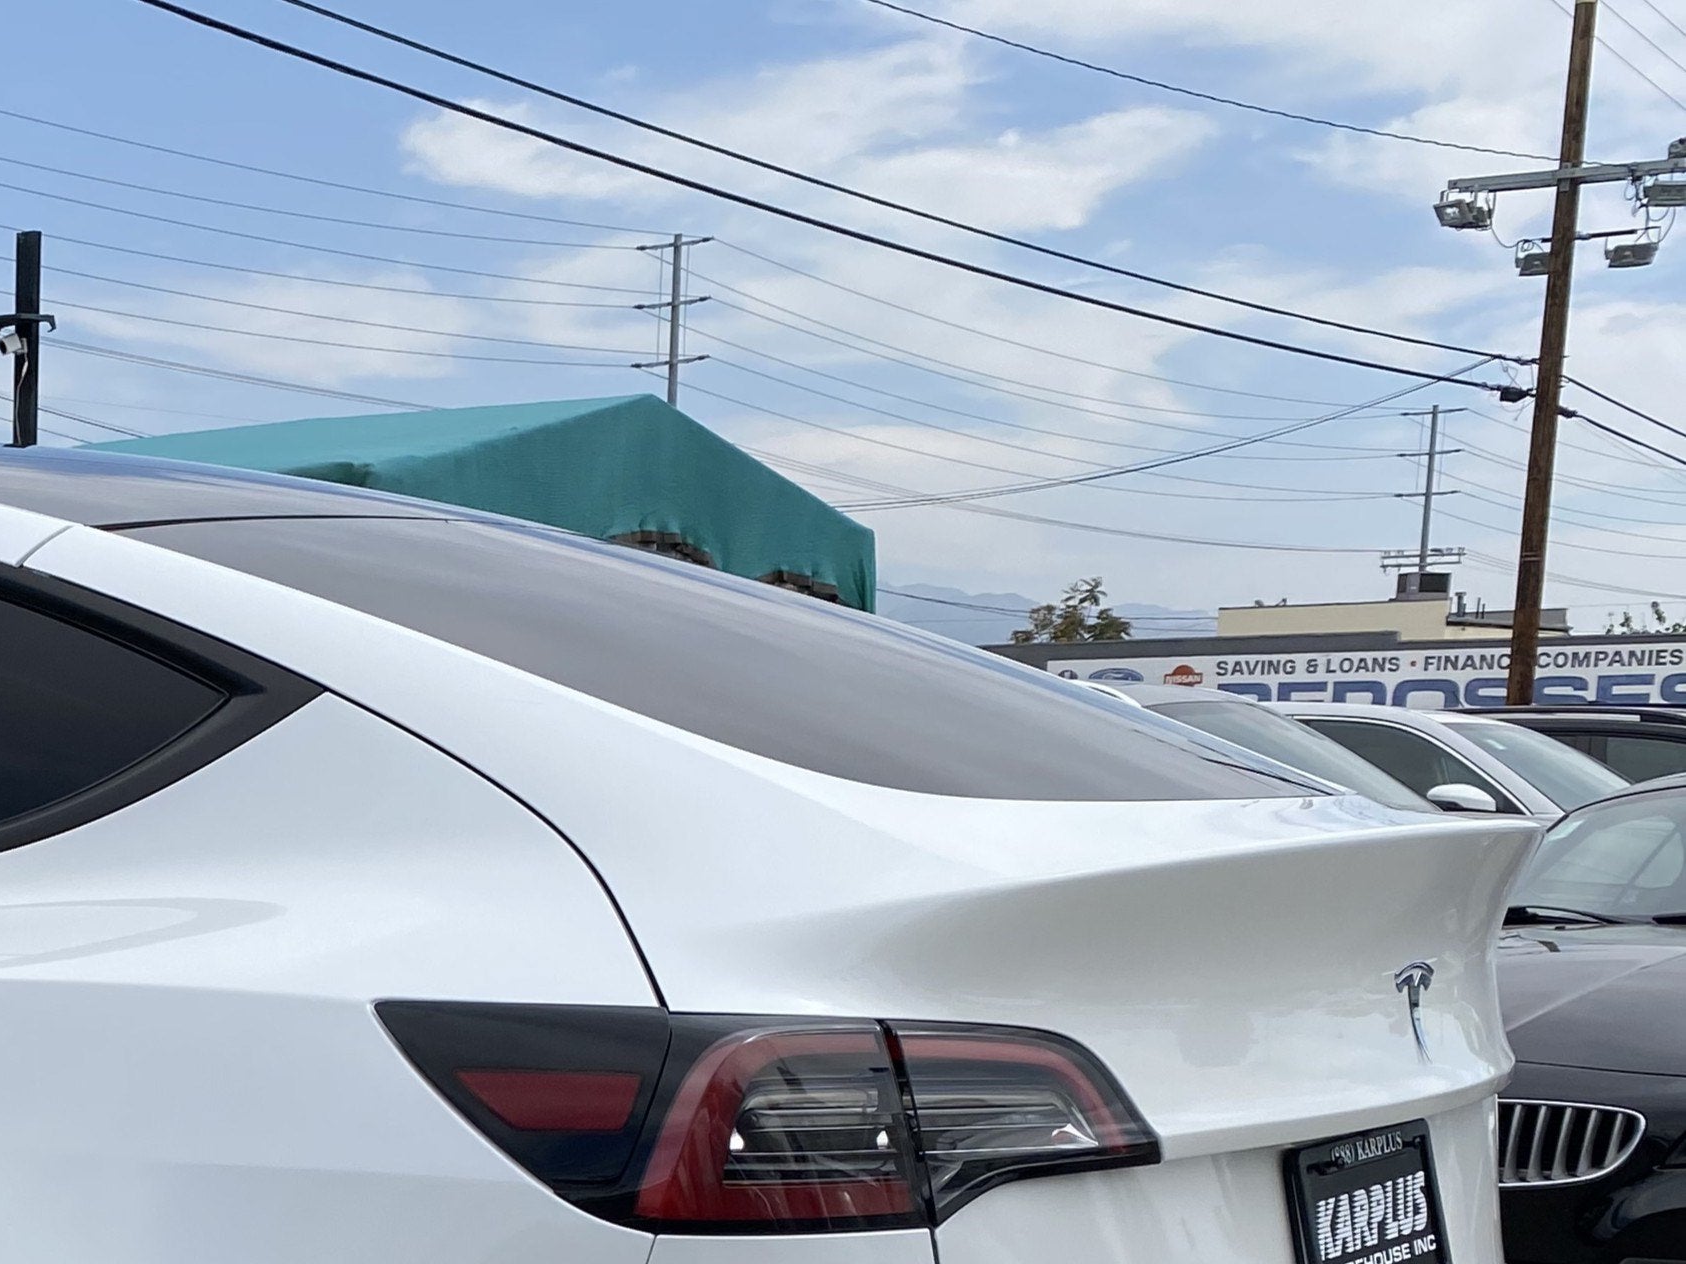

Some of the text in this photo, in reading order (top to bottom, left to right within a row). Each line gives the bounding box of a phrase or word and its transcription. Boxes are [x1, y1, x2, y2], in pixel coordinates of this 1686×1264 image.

[1215, 648, 1684, 677] SAVING & LOANS FINANC COMPANIES
[1164, 674, 1202, 685] NISSAN
[1356, 1131, 1403, 1161] KARPLUS
[1316, 1170, 1427, 1261] KARPLUS
[1413, 1234, 1437, 1256] INC
